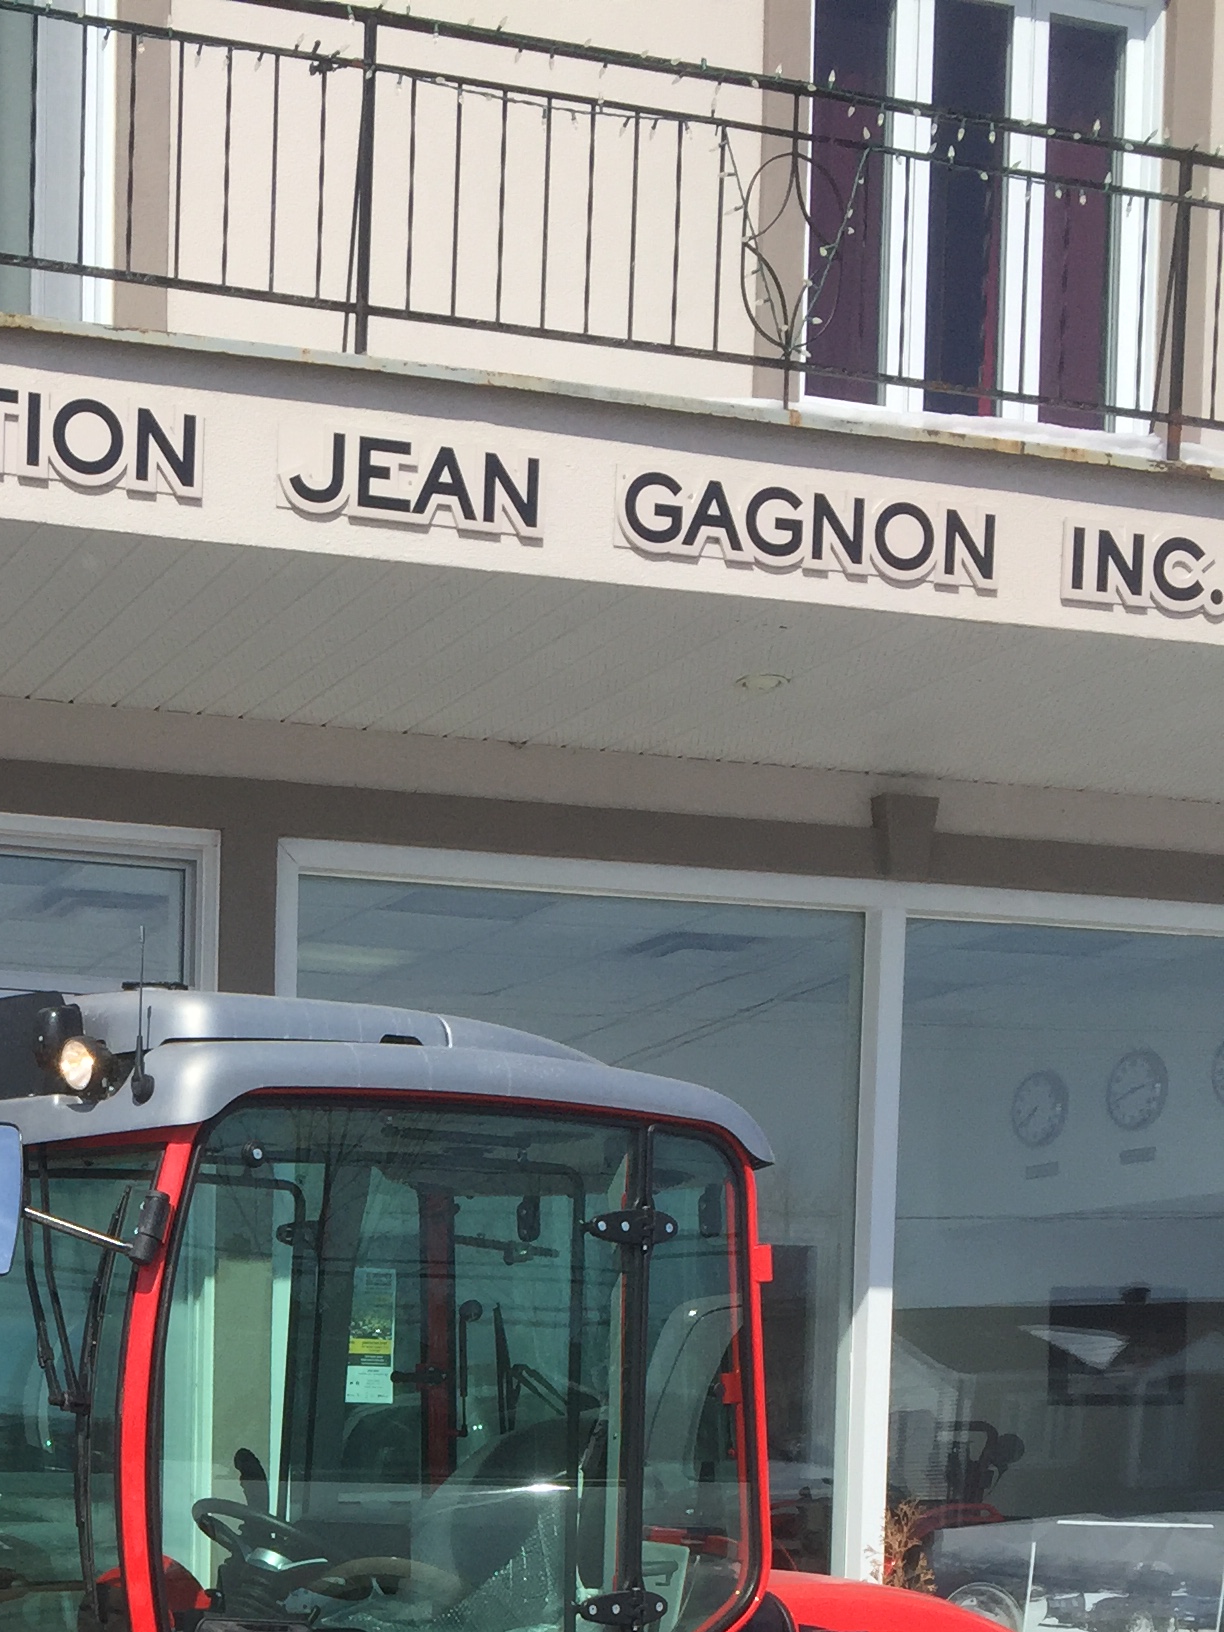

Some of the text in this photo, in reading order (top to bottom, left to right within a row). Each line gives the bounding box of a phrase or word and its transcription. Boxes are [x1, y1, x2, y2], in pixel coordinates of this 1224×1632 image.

[289, 433, 540, 528] JEAN
[625, 472, 997, 580] GAGNON
[1071, 526, 1223, 605] INC.
